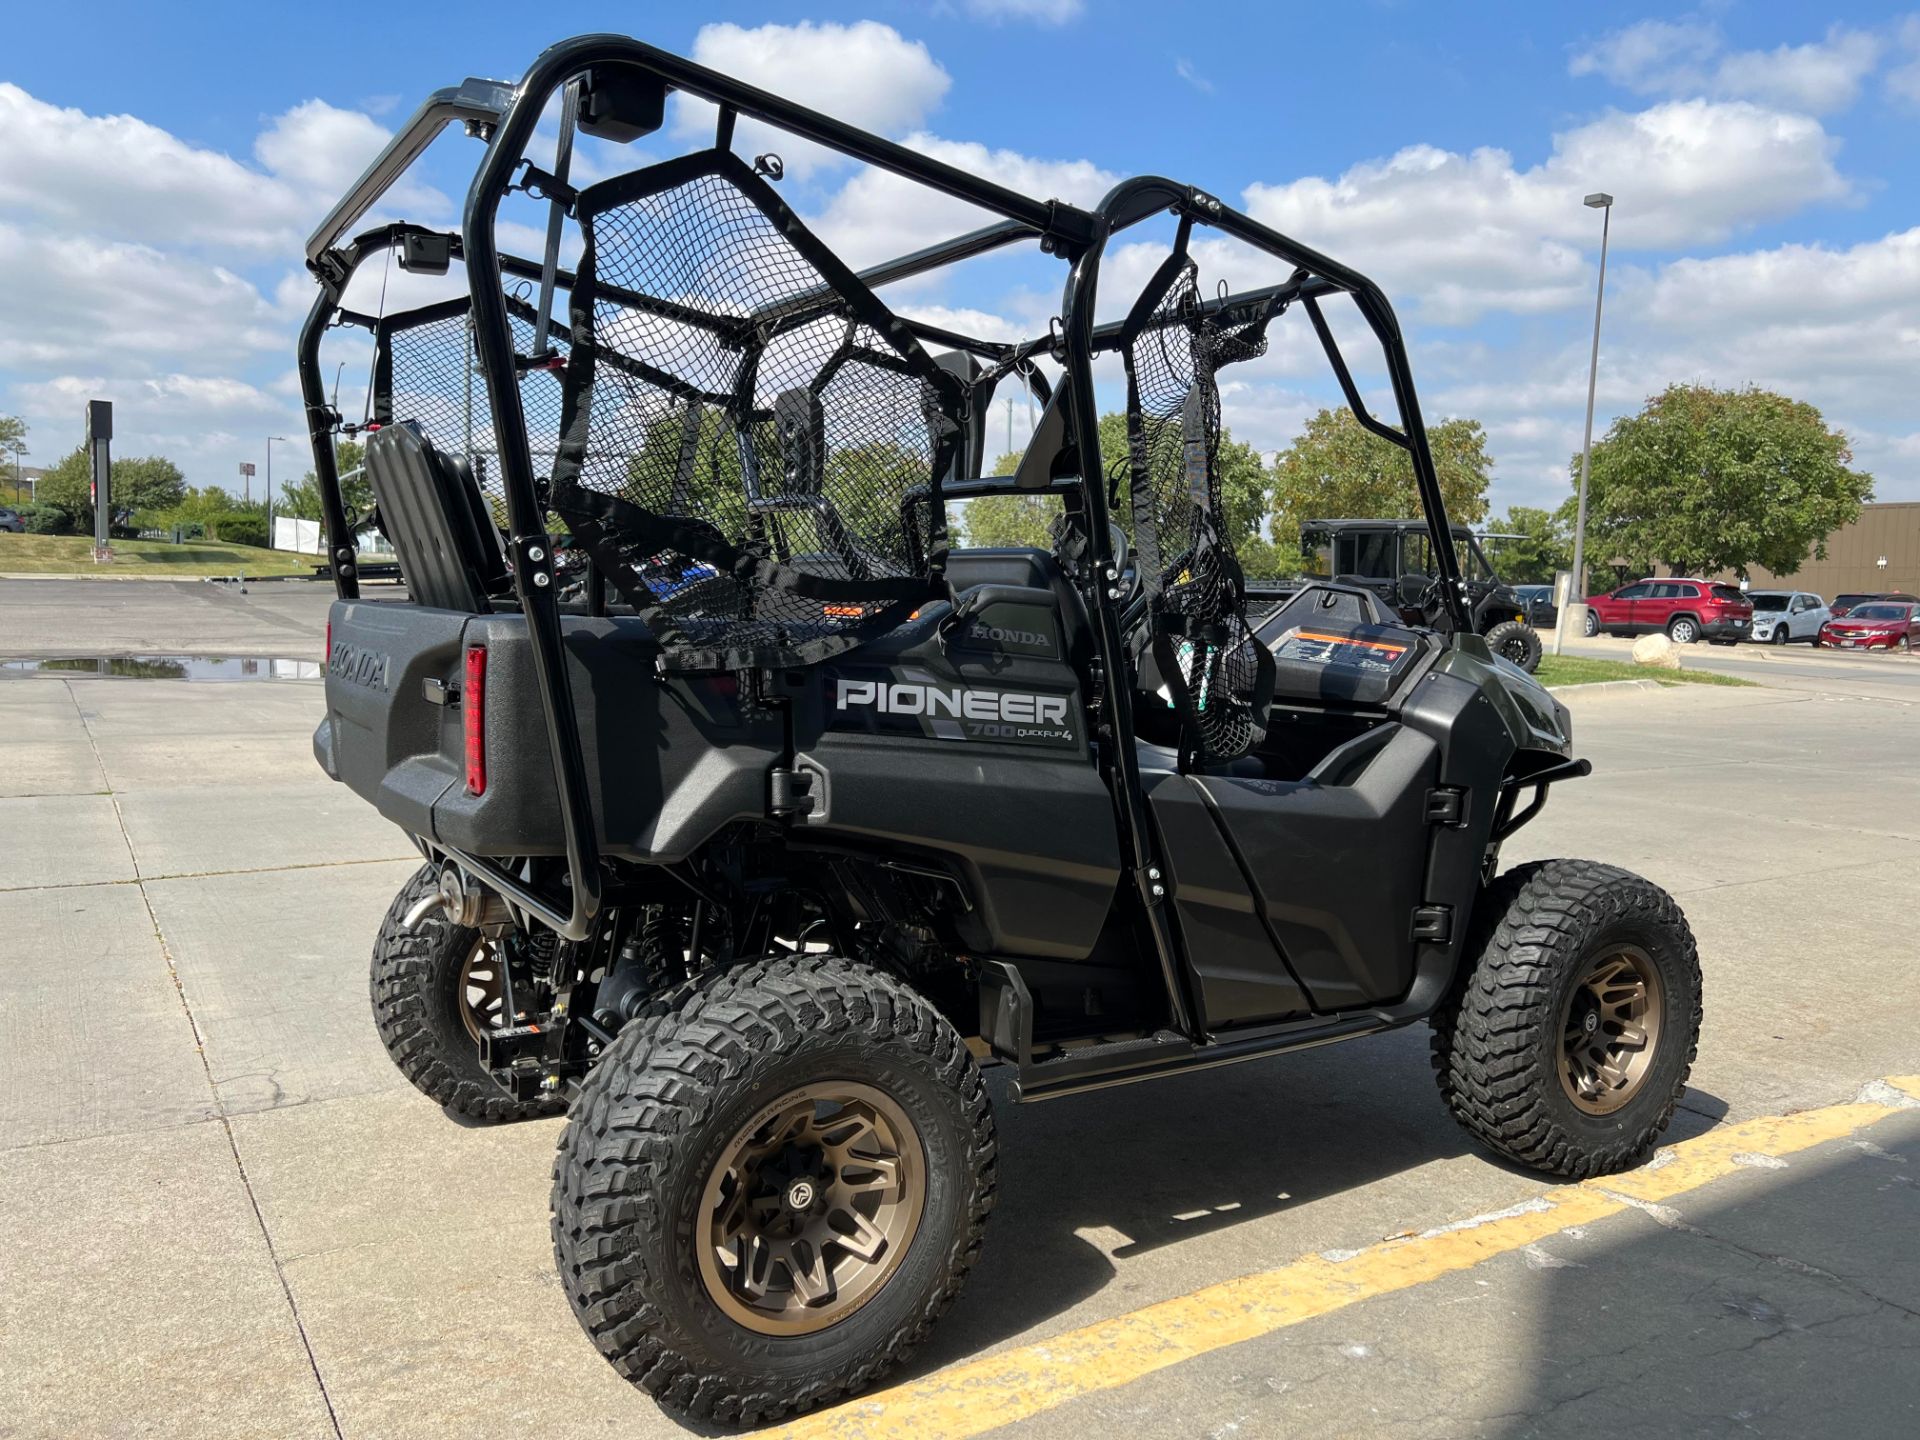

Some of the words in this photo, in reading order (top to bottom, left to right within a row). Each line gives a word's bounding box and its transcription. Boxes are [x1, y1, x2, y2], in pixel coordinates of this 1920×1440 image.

[970, 624, 1051, 648] HONDA
[330, 640, 391, 693] HONDA
[836, 679, 1067, 726] PIONEER
[967, 723, 1016, 738] 700
